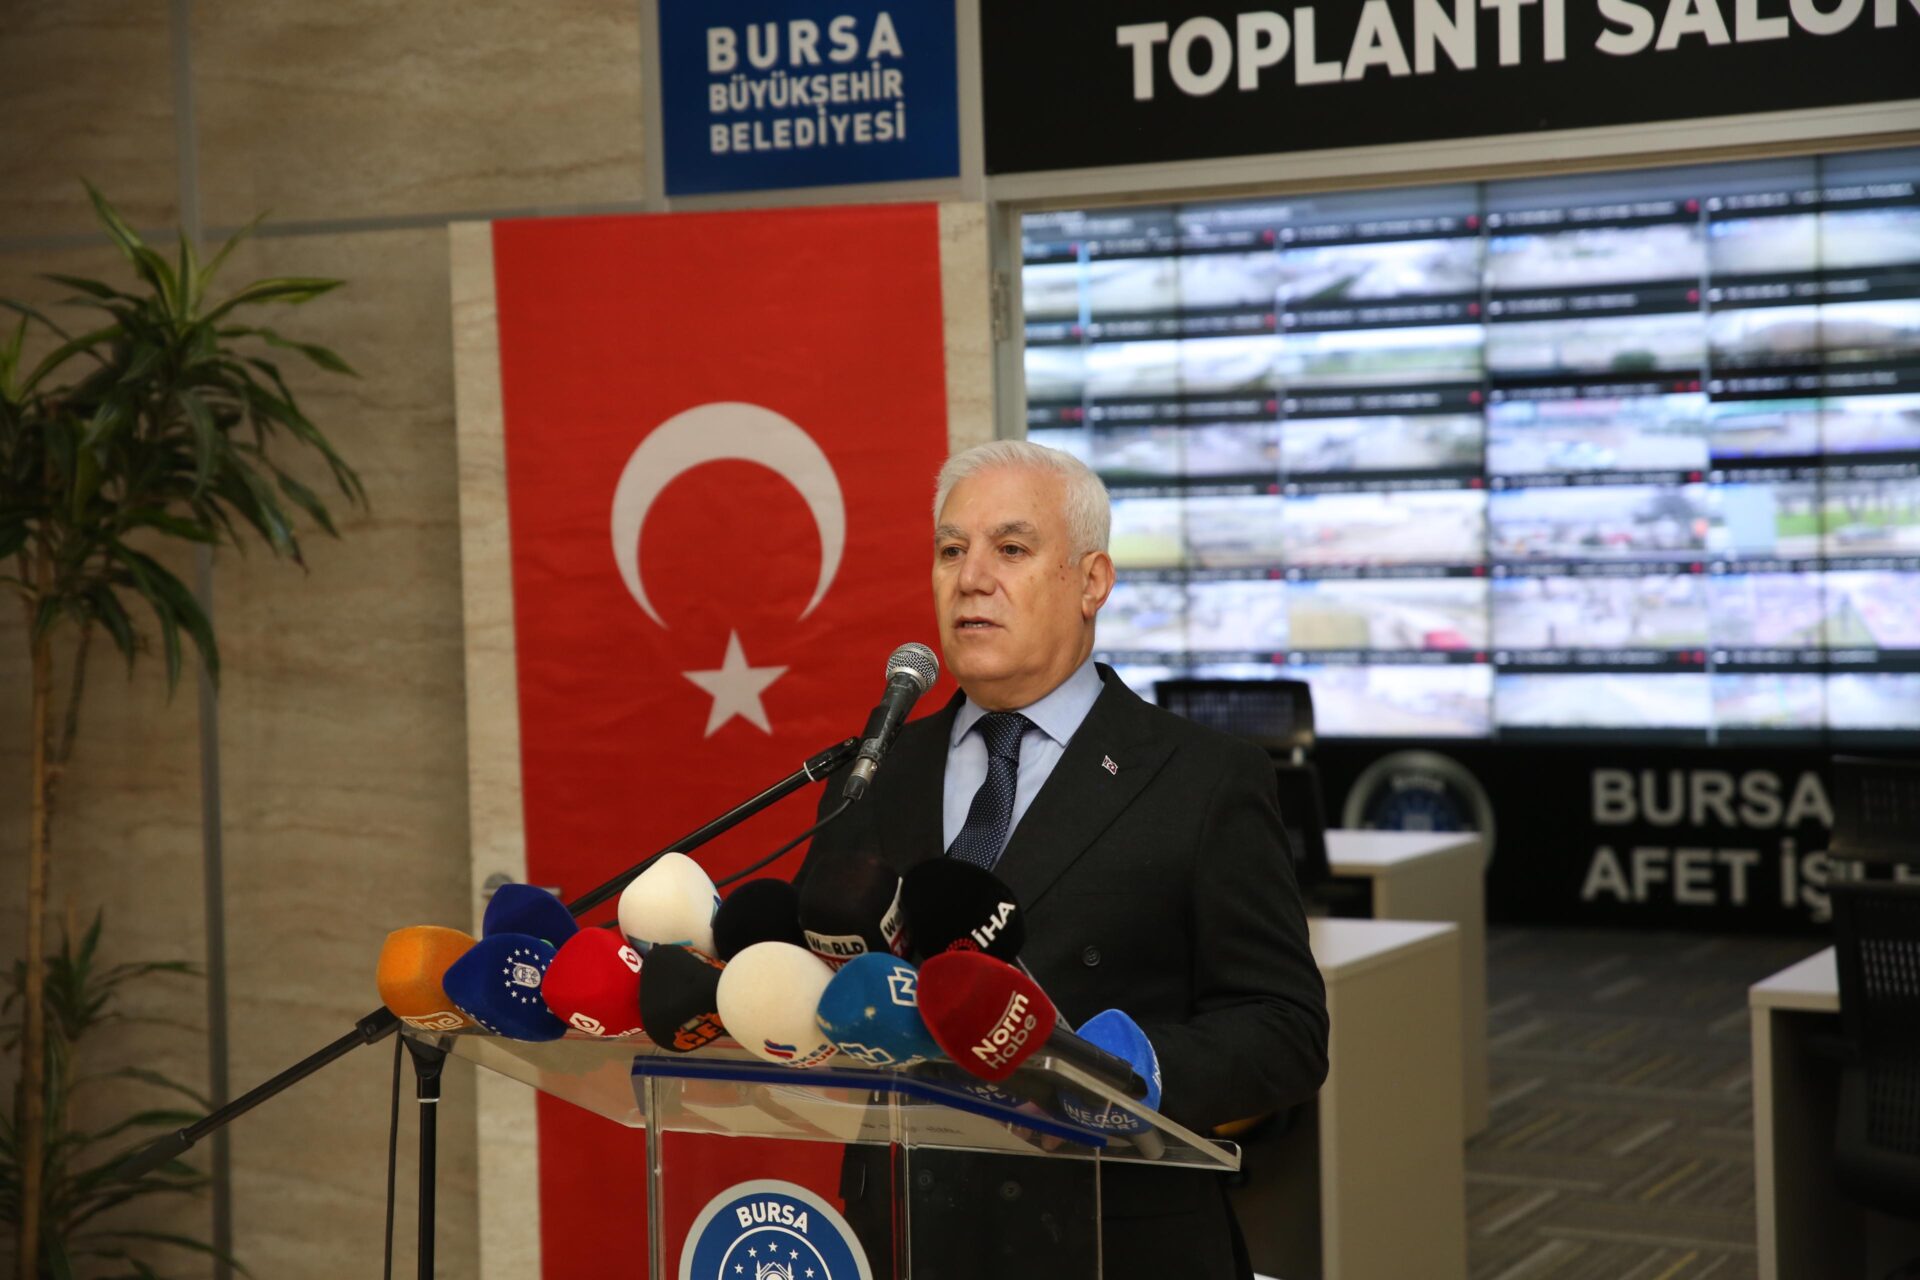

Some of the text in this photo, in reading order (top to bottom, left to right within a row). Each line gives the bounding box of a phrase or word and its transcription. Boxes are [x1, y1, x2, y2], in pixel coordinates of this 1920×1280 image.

[706, 11, 903, 73] BURSA
[1116, 0, 1566, 101] TOPLANTI
[708, 61, 904, 113] BÜYÜKŞEHİR
[710, 102, 906, 153] BELEDİYESİ
[1592, 769, 1833, 828] BURSA
[1581, 846, 1758, 907] AFET
[970, 901, 1016, 949] İHA
[971, 993, 1030, 1061] Norm
[735, 1201, 809, 1235] BURSA
